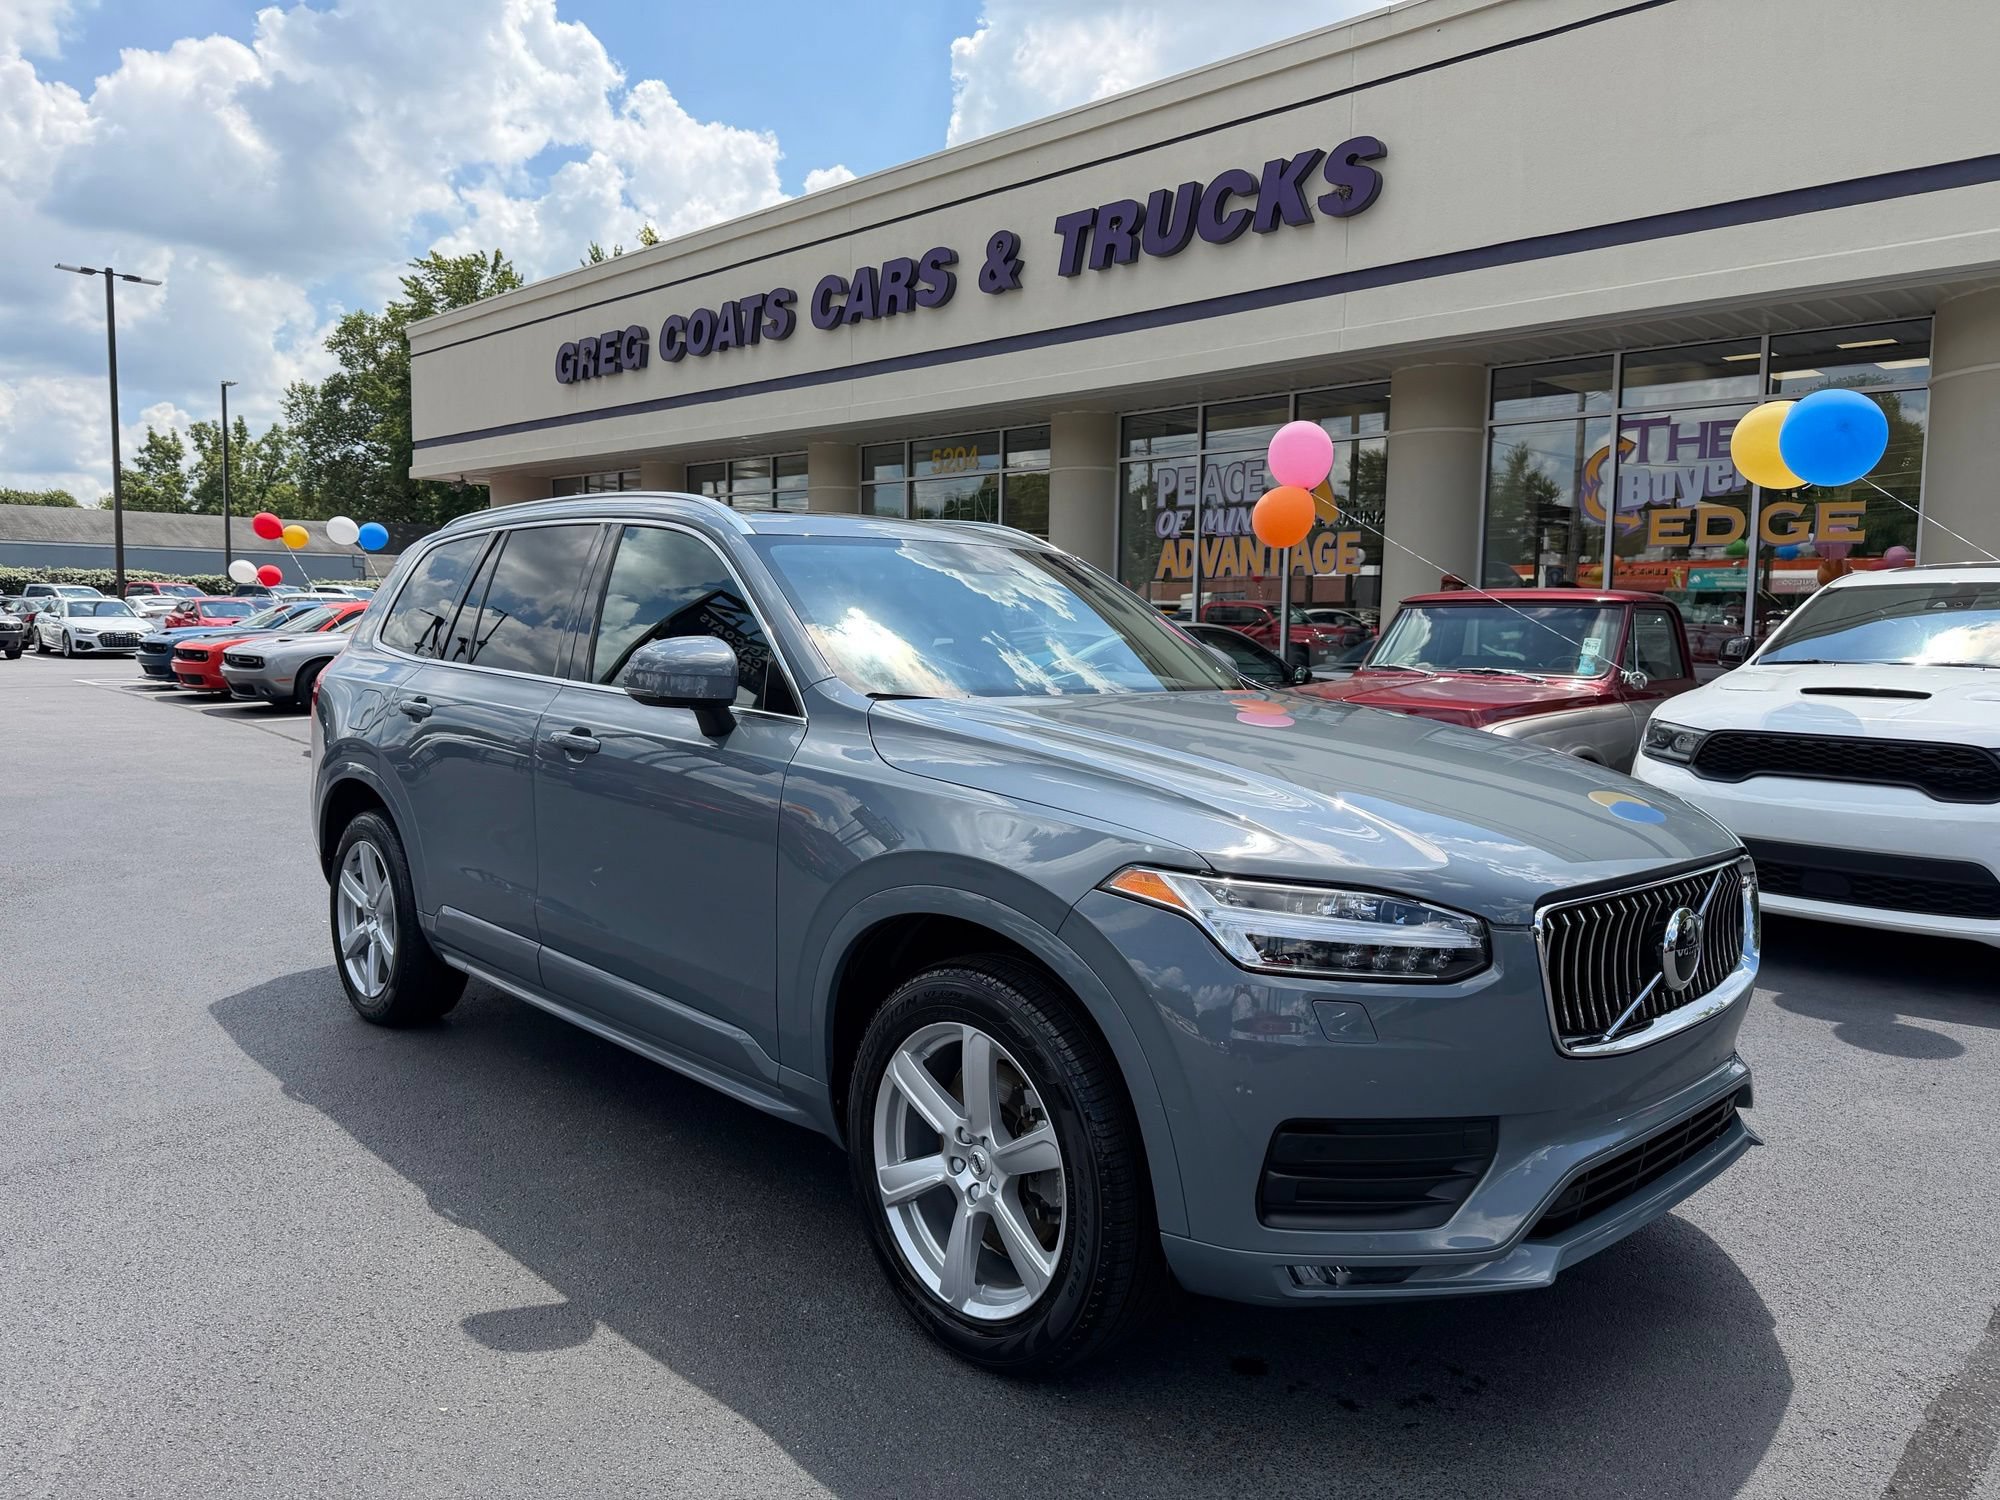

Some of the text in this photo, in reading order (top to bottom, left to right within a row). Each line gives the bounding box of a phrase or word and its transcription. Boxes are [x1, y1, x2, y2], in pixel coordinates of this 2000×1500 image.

[555, 135, 1388, 384] GREG COATS CARS & TRUCKS
[931, 445, 979, 474] 5204
[1619, 416, 1738, 463] THE
[1156, 459, 1266, 508] PEACE
[1155, 506, 1255, 538] OF MIN
[1647, 500, 1867, 548] EDGE
[1155, 531, 1362, 579] ADVANTAGE
